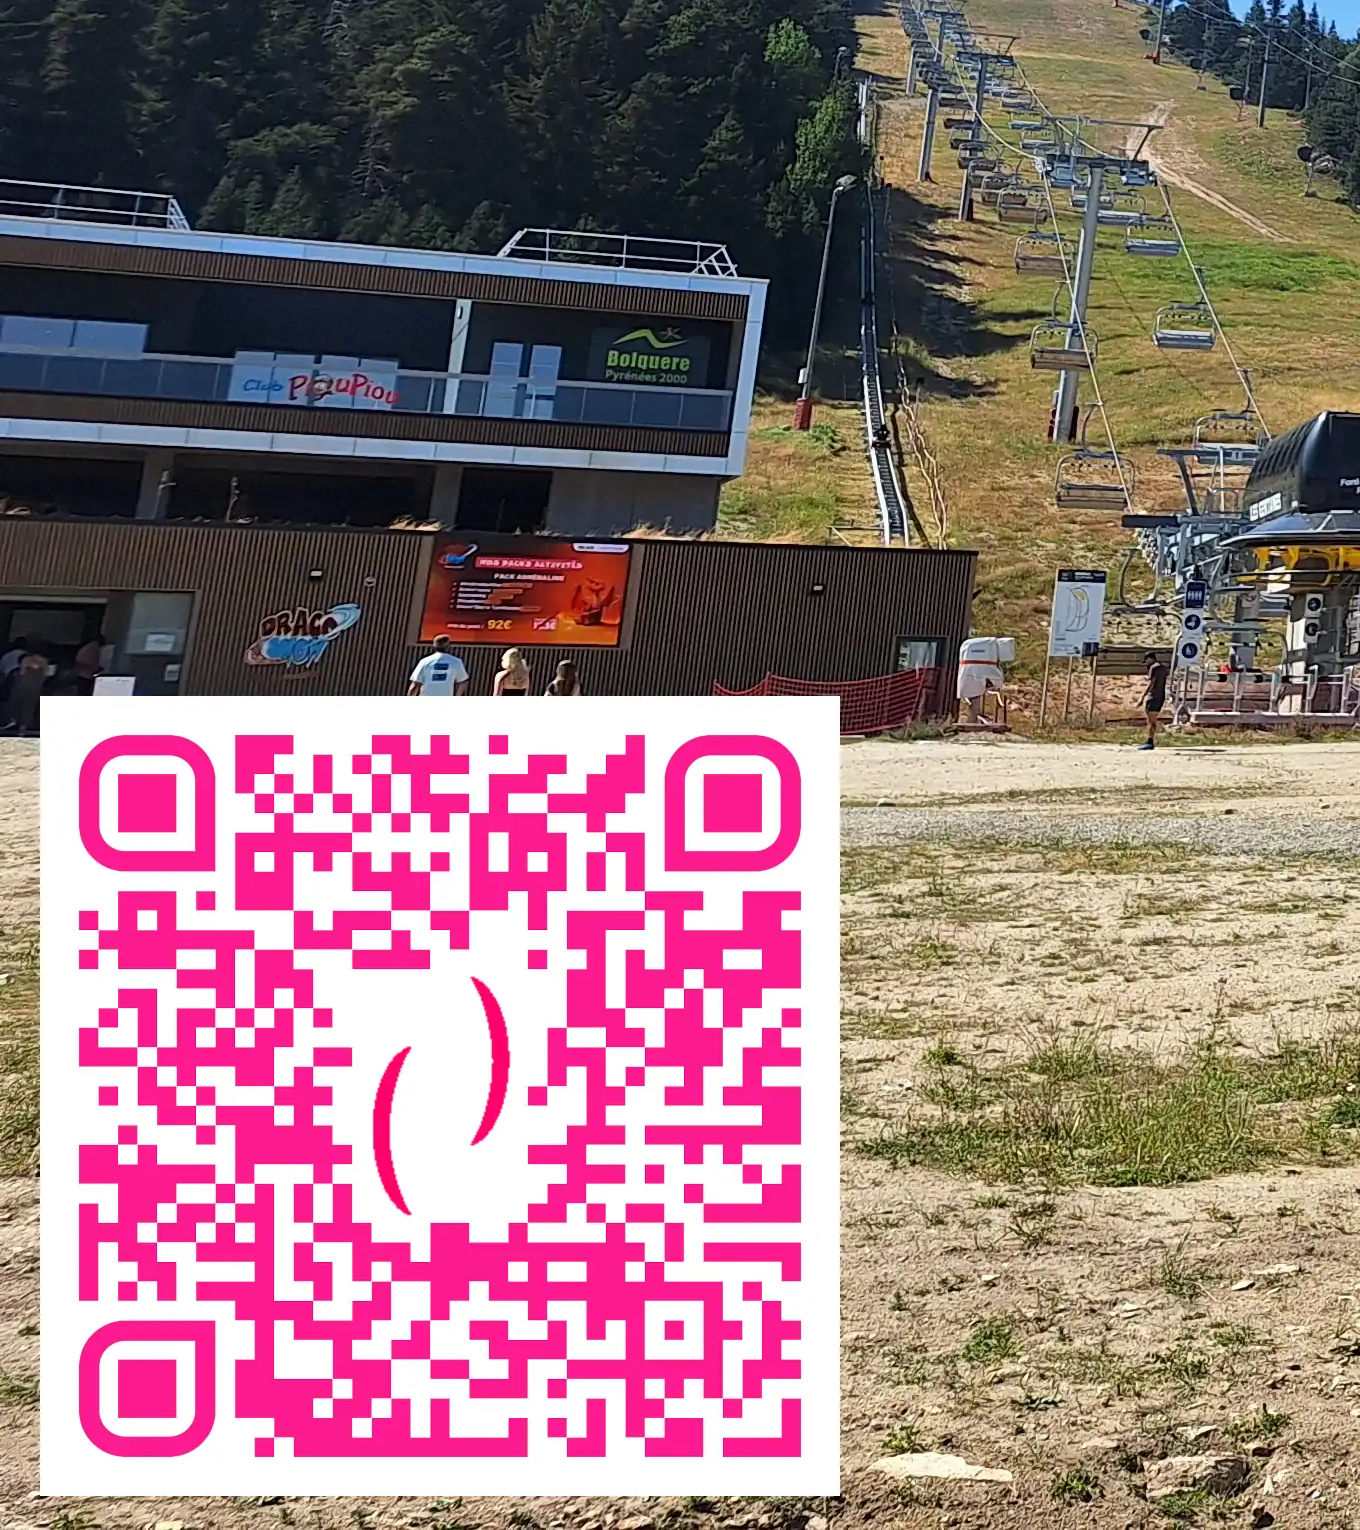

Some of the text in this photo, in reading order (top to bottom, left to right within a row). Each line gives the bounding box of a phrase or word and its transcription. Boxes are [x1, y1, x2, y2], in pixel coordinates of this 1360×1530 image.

[606, 349, 690, 372] Bolquere
[605, 368, 688, 384] Pyrénées 2000
[242, 378, 284, 392] Club
[487, 619, 514, 631] 92€
